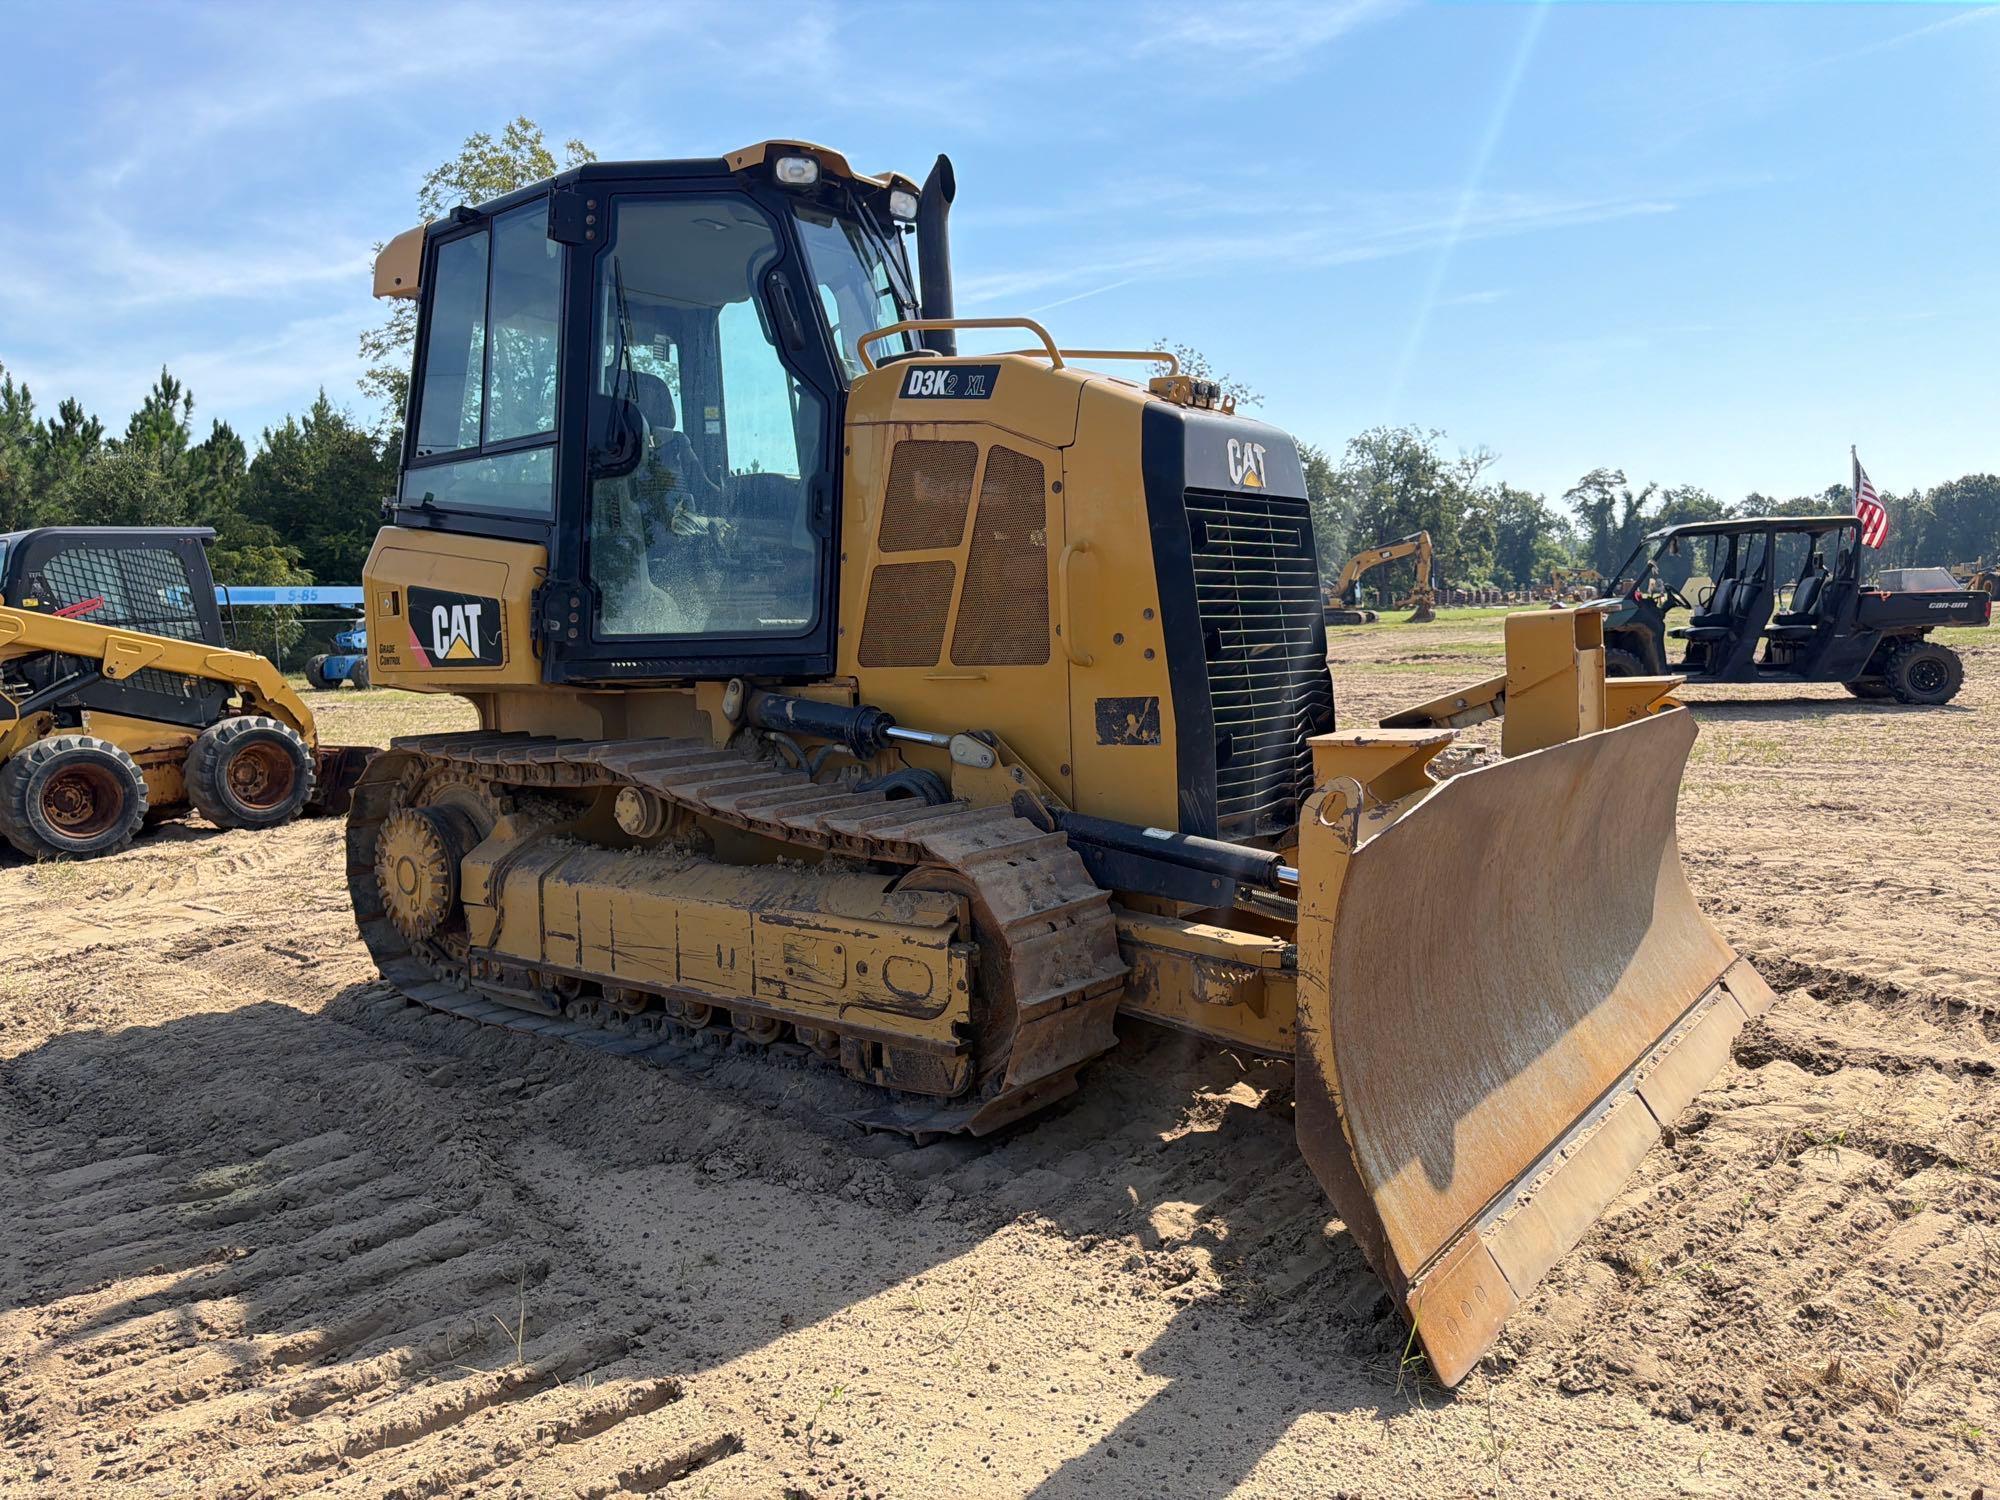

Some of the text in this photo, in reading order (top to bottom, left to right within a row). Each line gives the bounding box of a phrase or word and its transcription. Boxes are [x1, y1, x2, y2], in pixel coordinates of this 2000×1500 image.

[964, 375, 986, 396] XL
[1227, 438, 1266, 488] CAT
[288, 589, 318, 601] S-85
[431, 603, 482, 660] CAT
